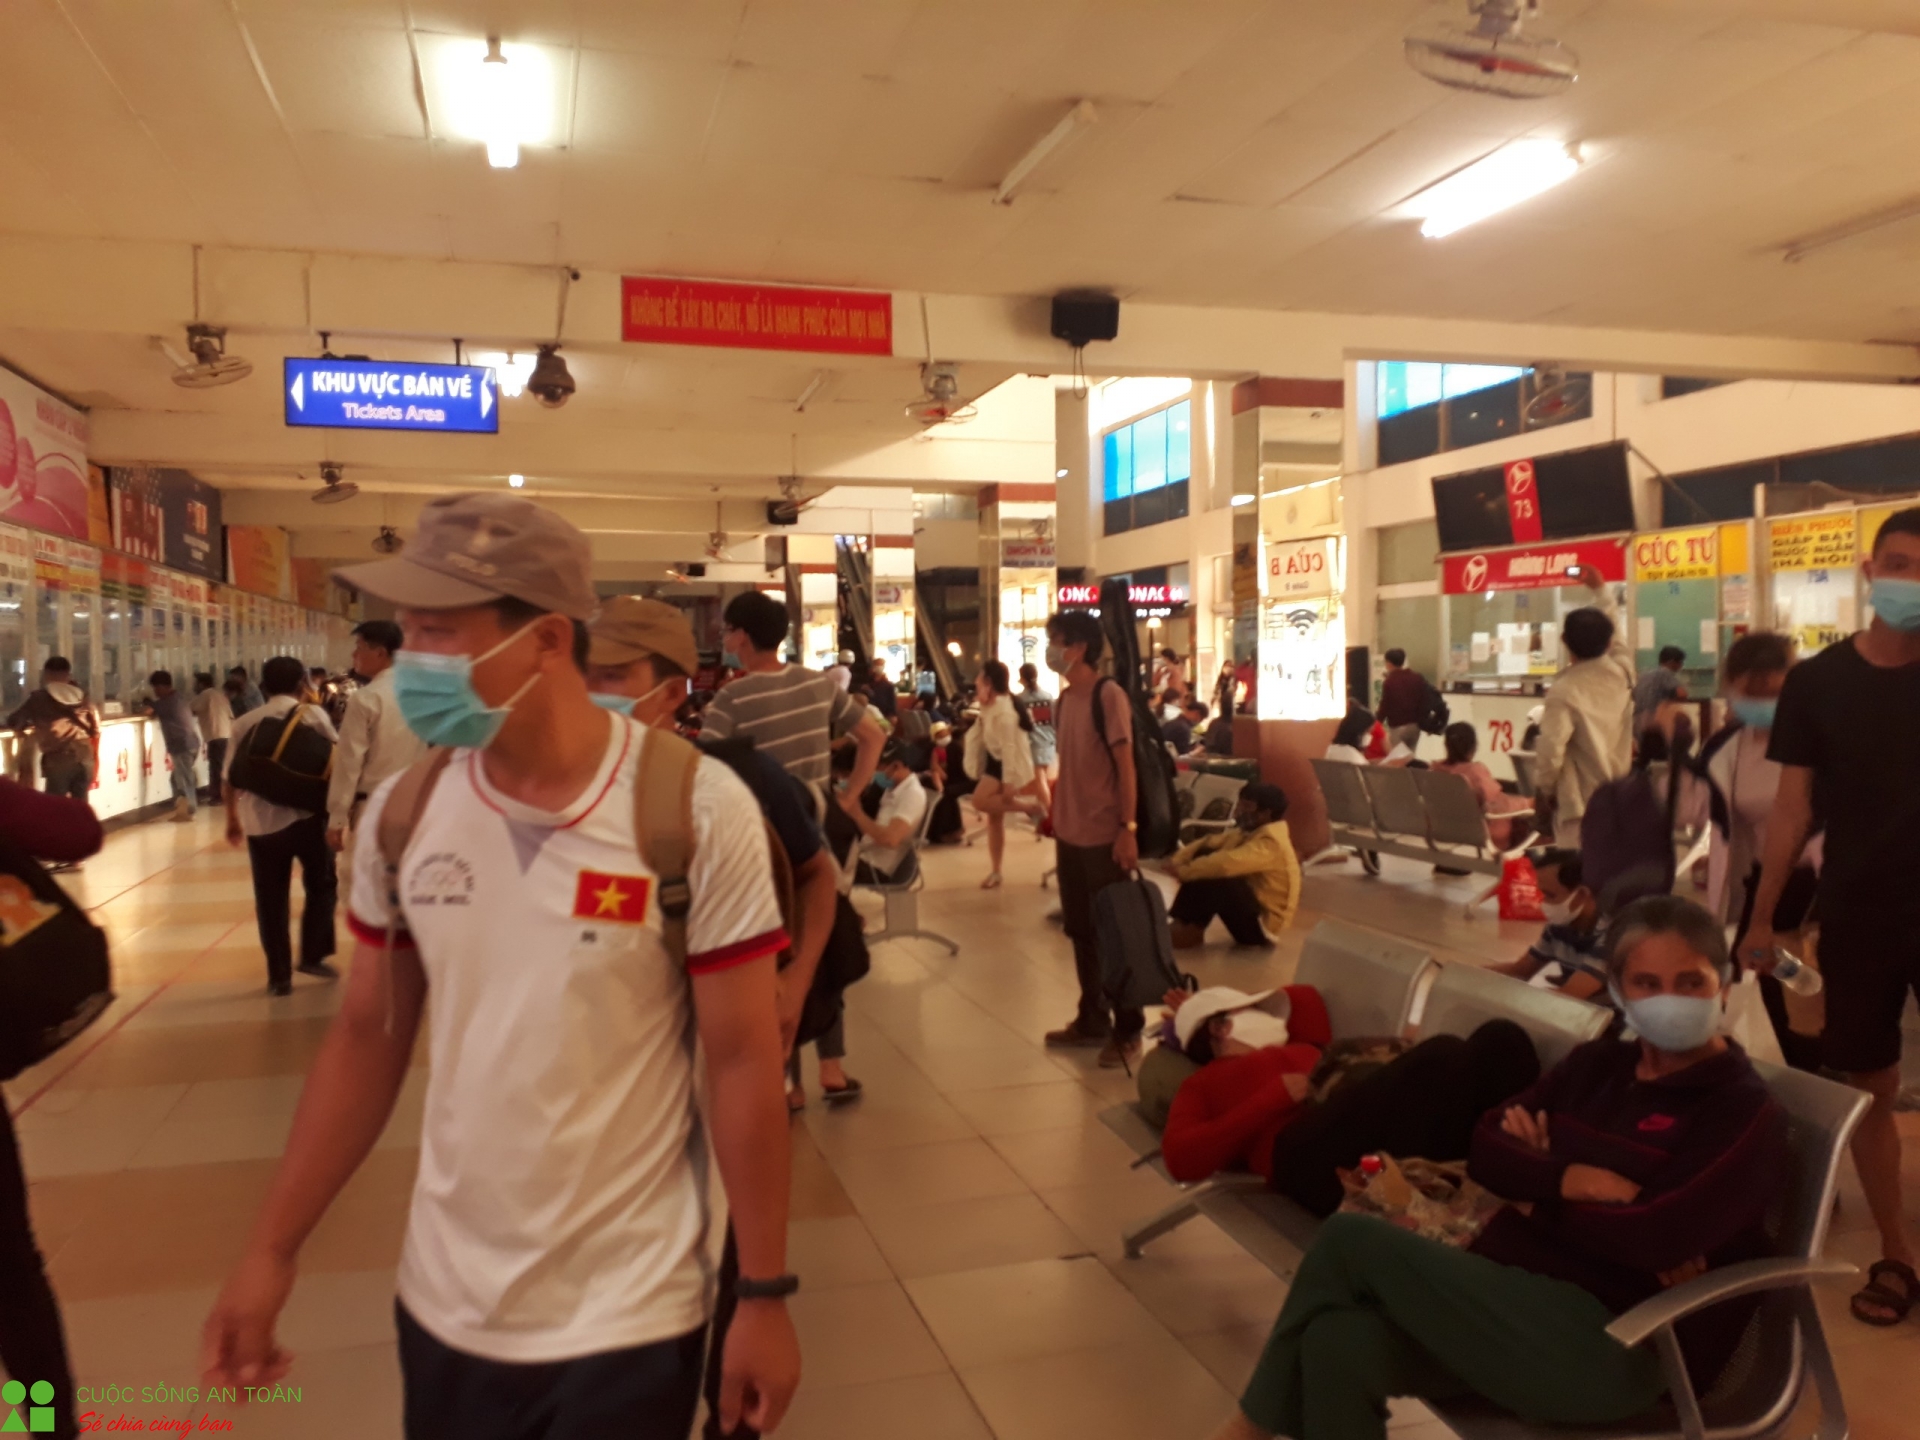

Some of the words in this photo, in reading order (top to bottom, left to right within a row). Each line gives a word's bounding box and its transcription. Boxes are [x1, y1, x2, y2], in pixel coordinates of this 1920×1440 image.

[312, 371, 356, 393] KHU
[357, 371, 399, 399] VỰC
[403, 372, 443, 397] BÁN
[447, 374, 472, 398] VÉ
[342, 402, 402, 420] Tickets
[406, 405, 445, 421] Area
[1514, 498, 1533, 519] 73
[1637, 536, 1679, 567] CÚC
[1489, 719, 1514, 753] 73
